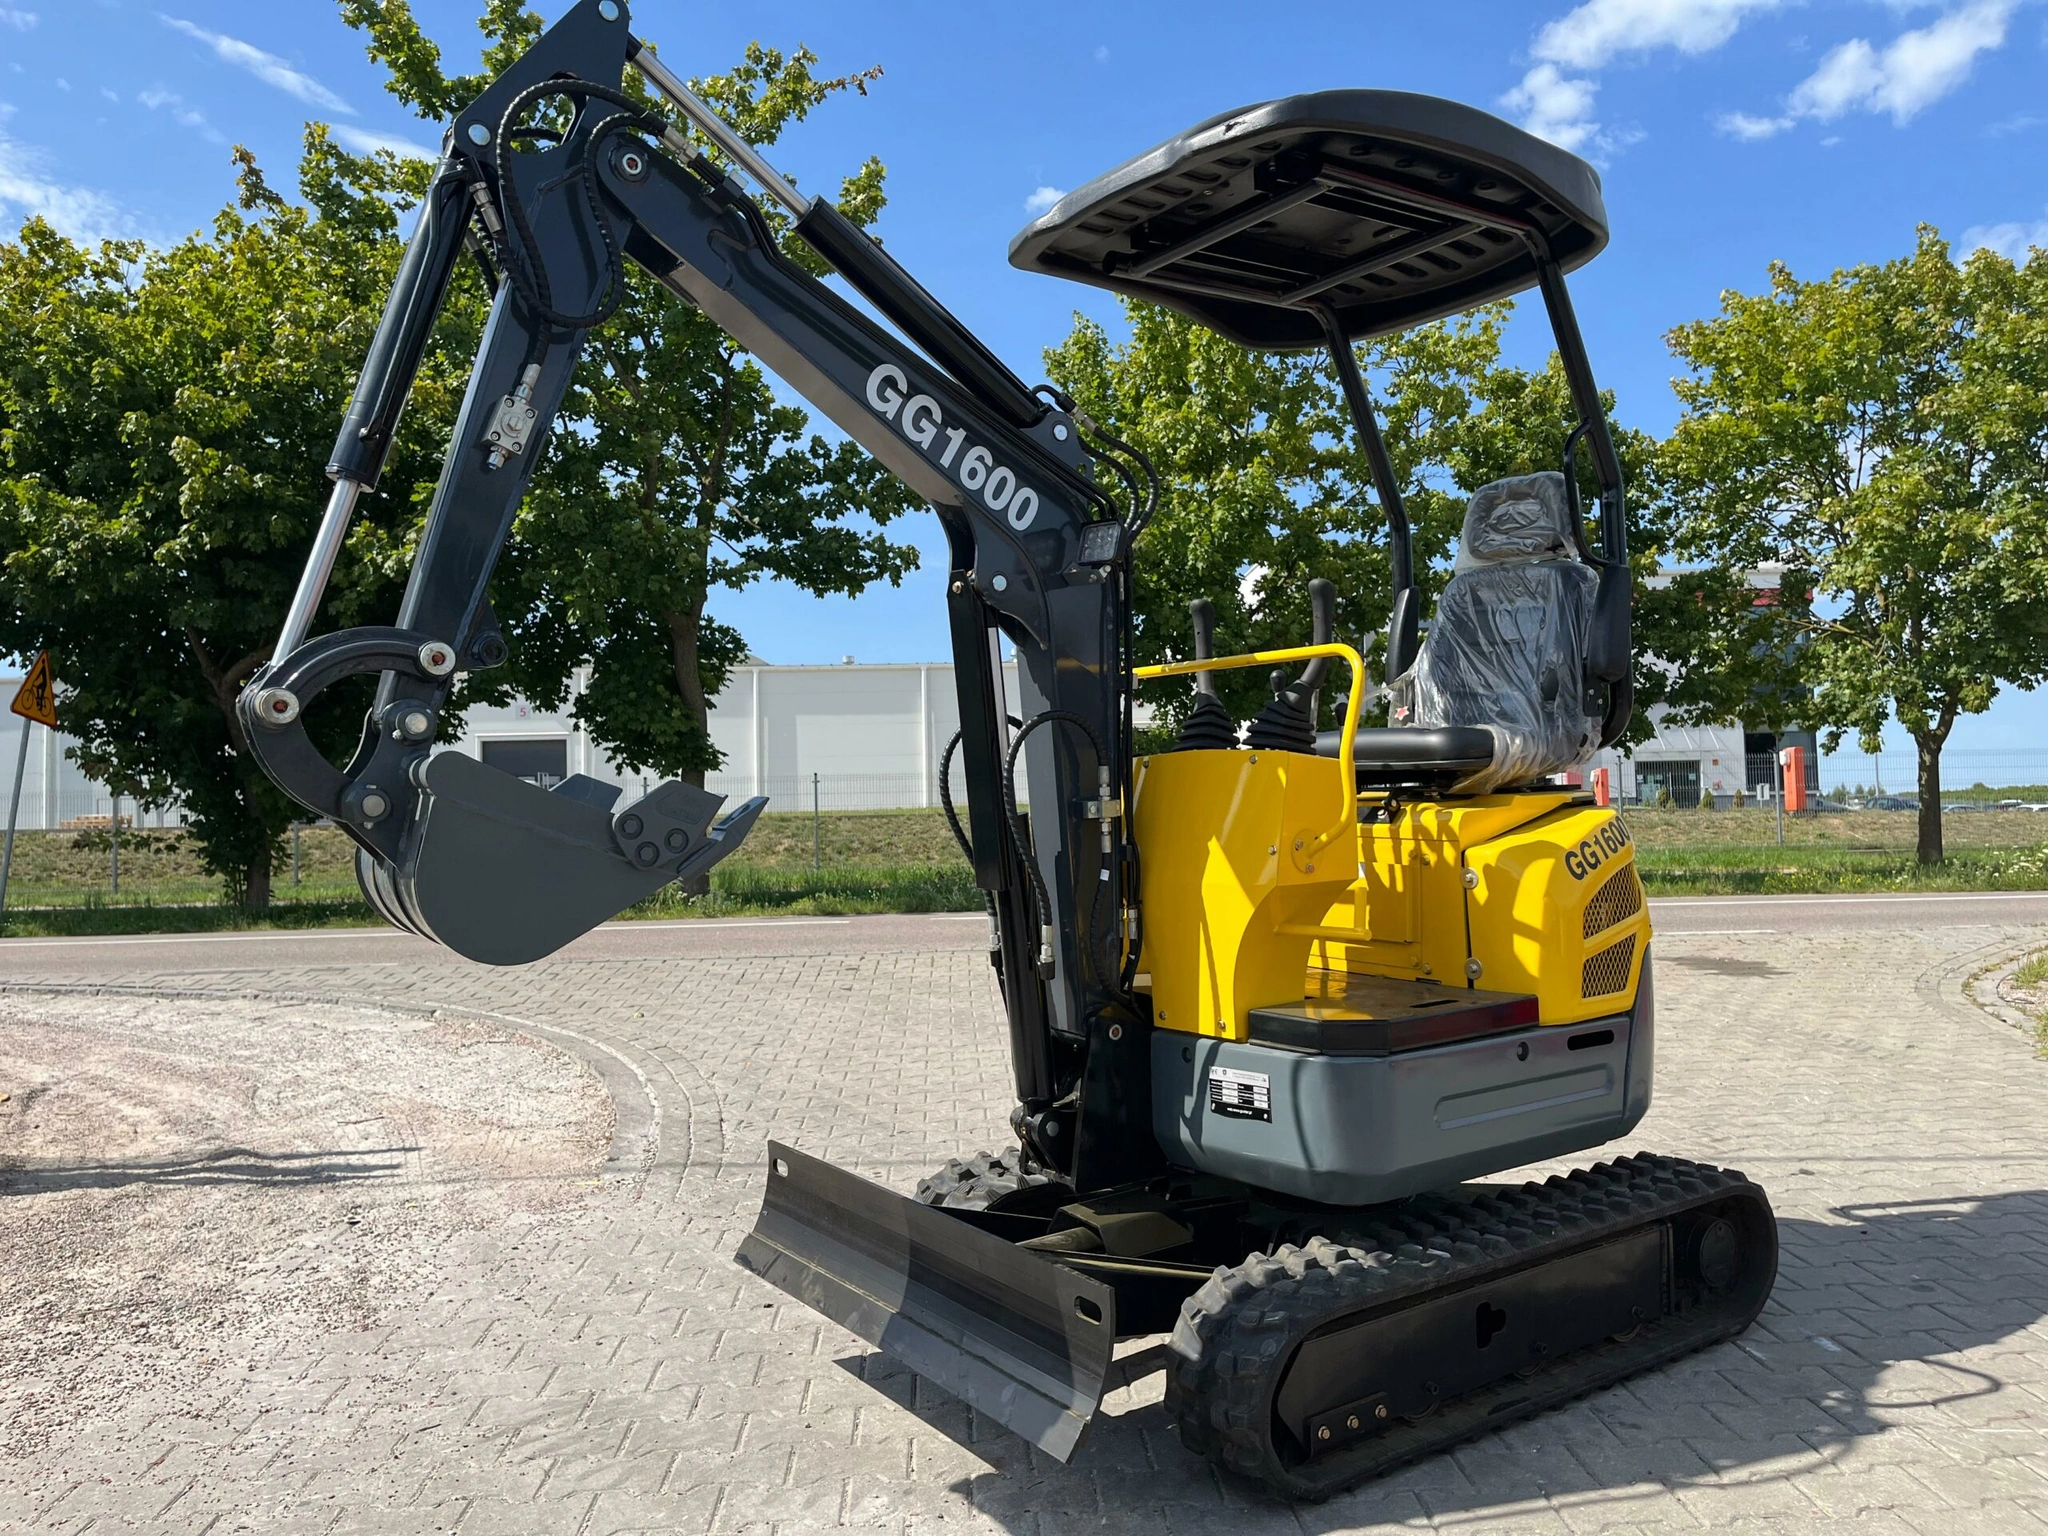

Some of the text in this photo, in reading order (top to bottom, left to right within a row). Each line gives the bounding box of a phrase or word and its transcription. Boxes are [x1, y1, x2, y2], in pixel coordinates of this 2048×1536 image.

[866, 363, 1039, 531] GG1600
[519, 707, 527, 717] 5
[1564, 815, 1631, 881] GG1600
